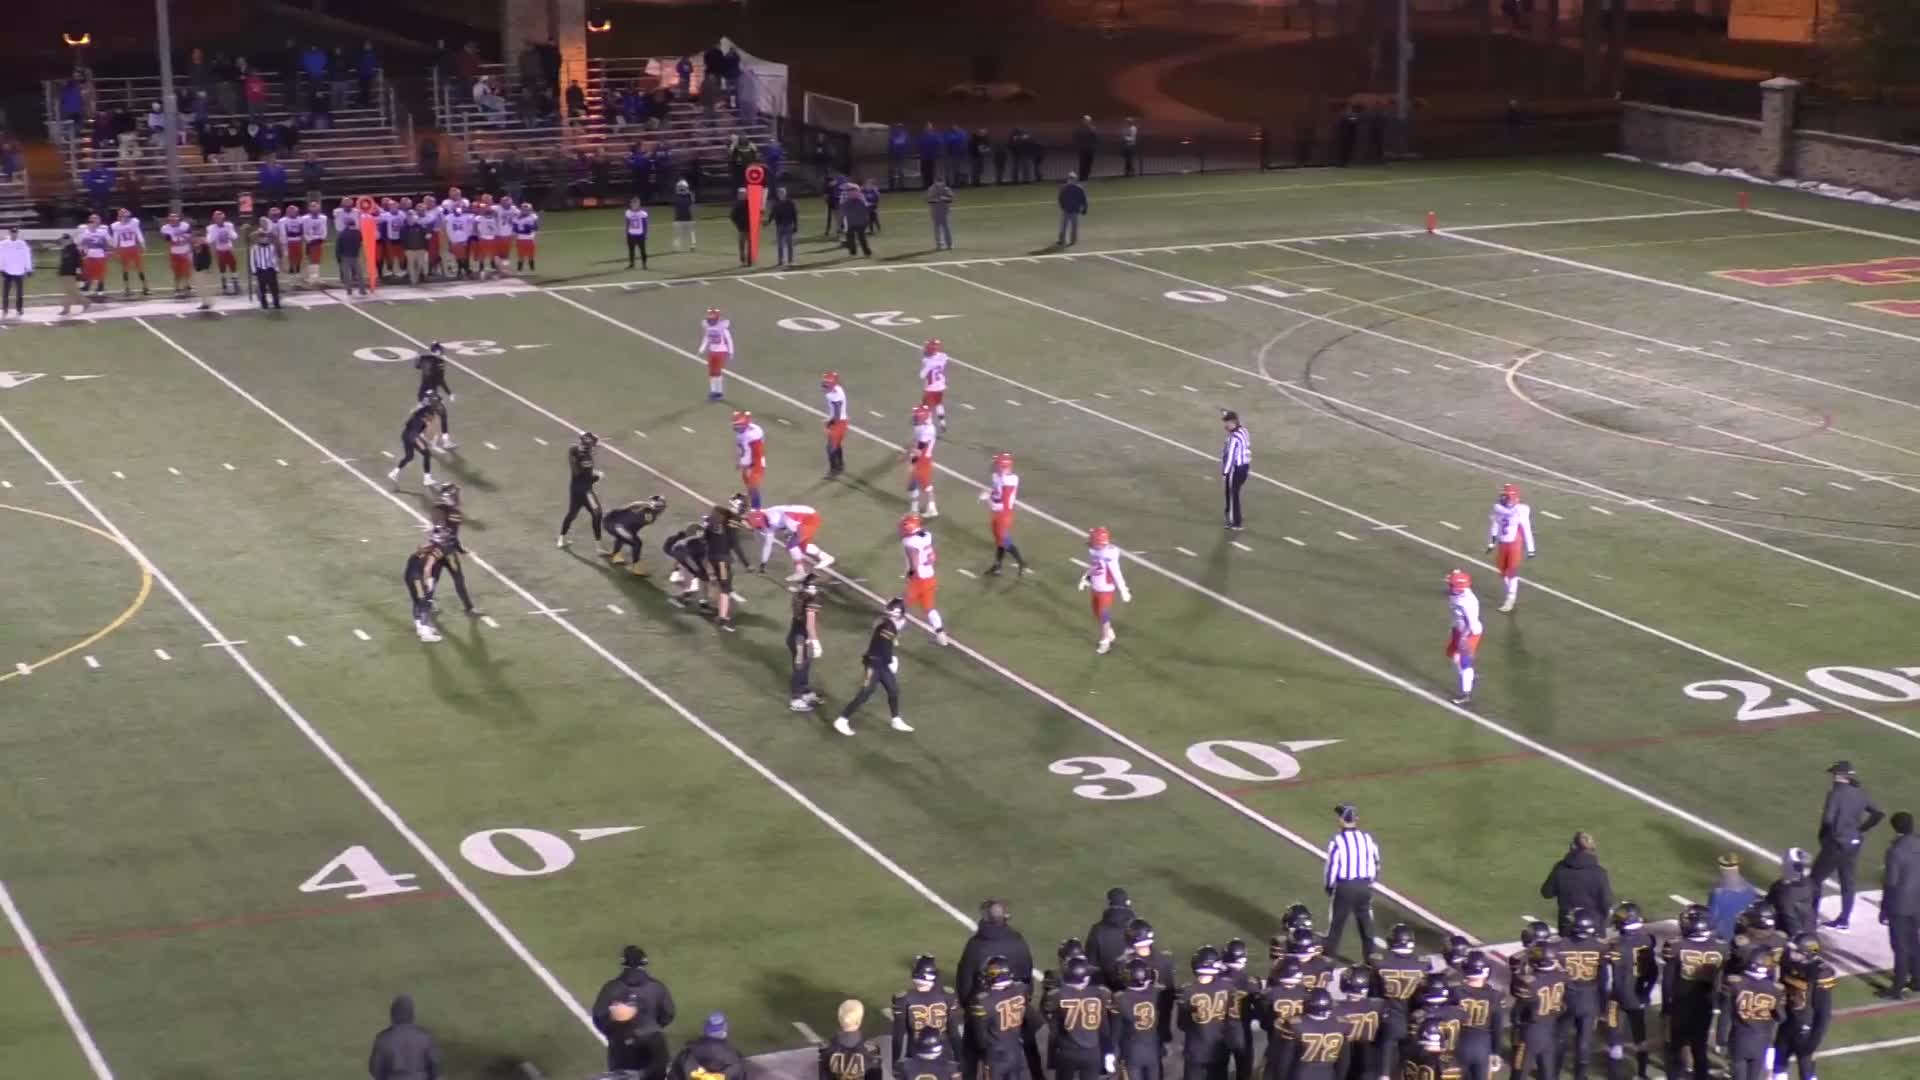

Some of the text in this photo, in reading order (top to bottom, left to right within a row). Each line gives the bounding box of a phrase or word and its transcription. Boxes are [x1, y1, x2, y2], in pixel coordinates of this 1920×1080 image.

[1048, 740, 1301, 800] 30
[299, 828, 575, 899] 40
[1378, 968, 1424, 1000] 57
[1060, 997, 1102, 1031] 78
[1133, 1001, 1155, 1031] 3
